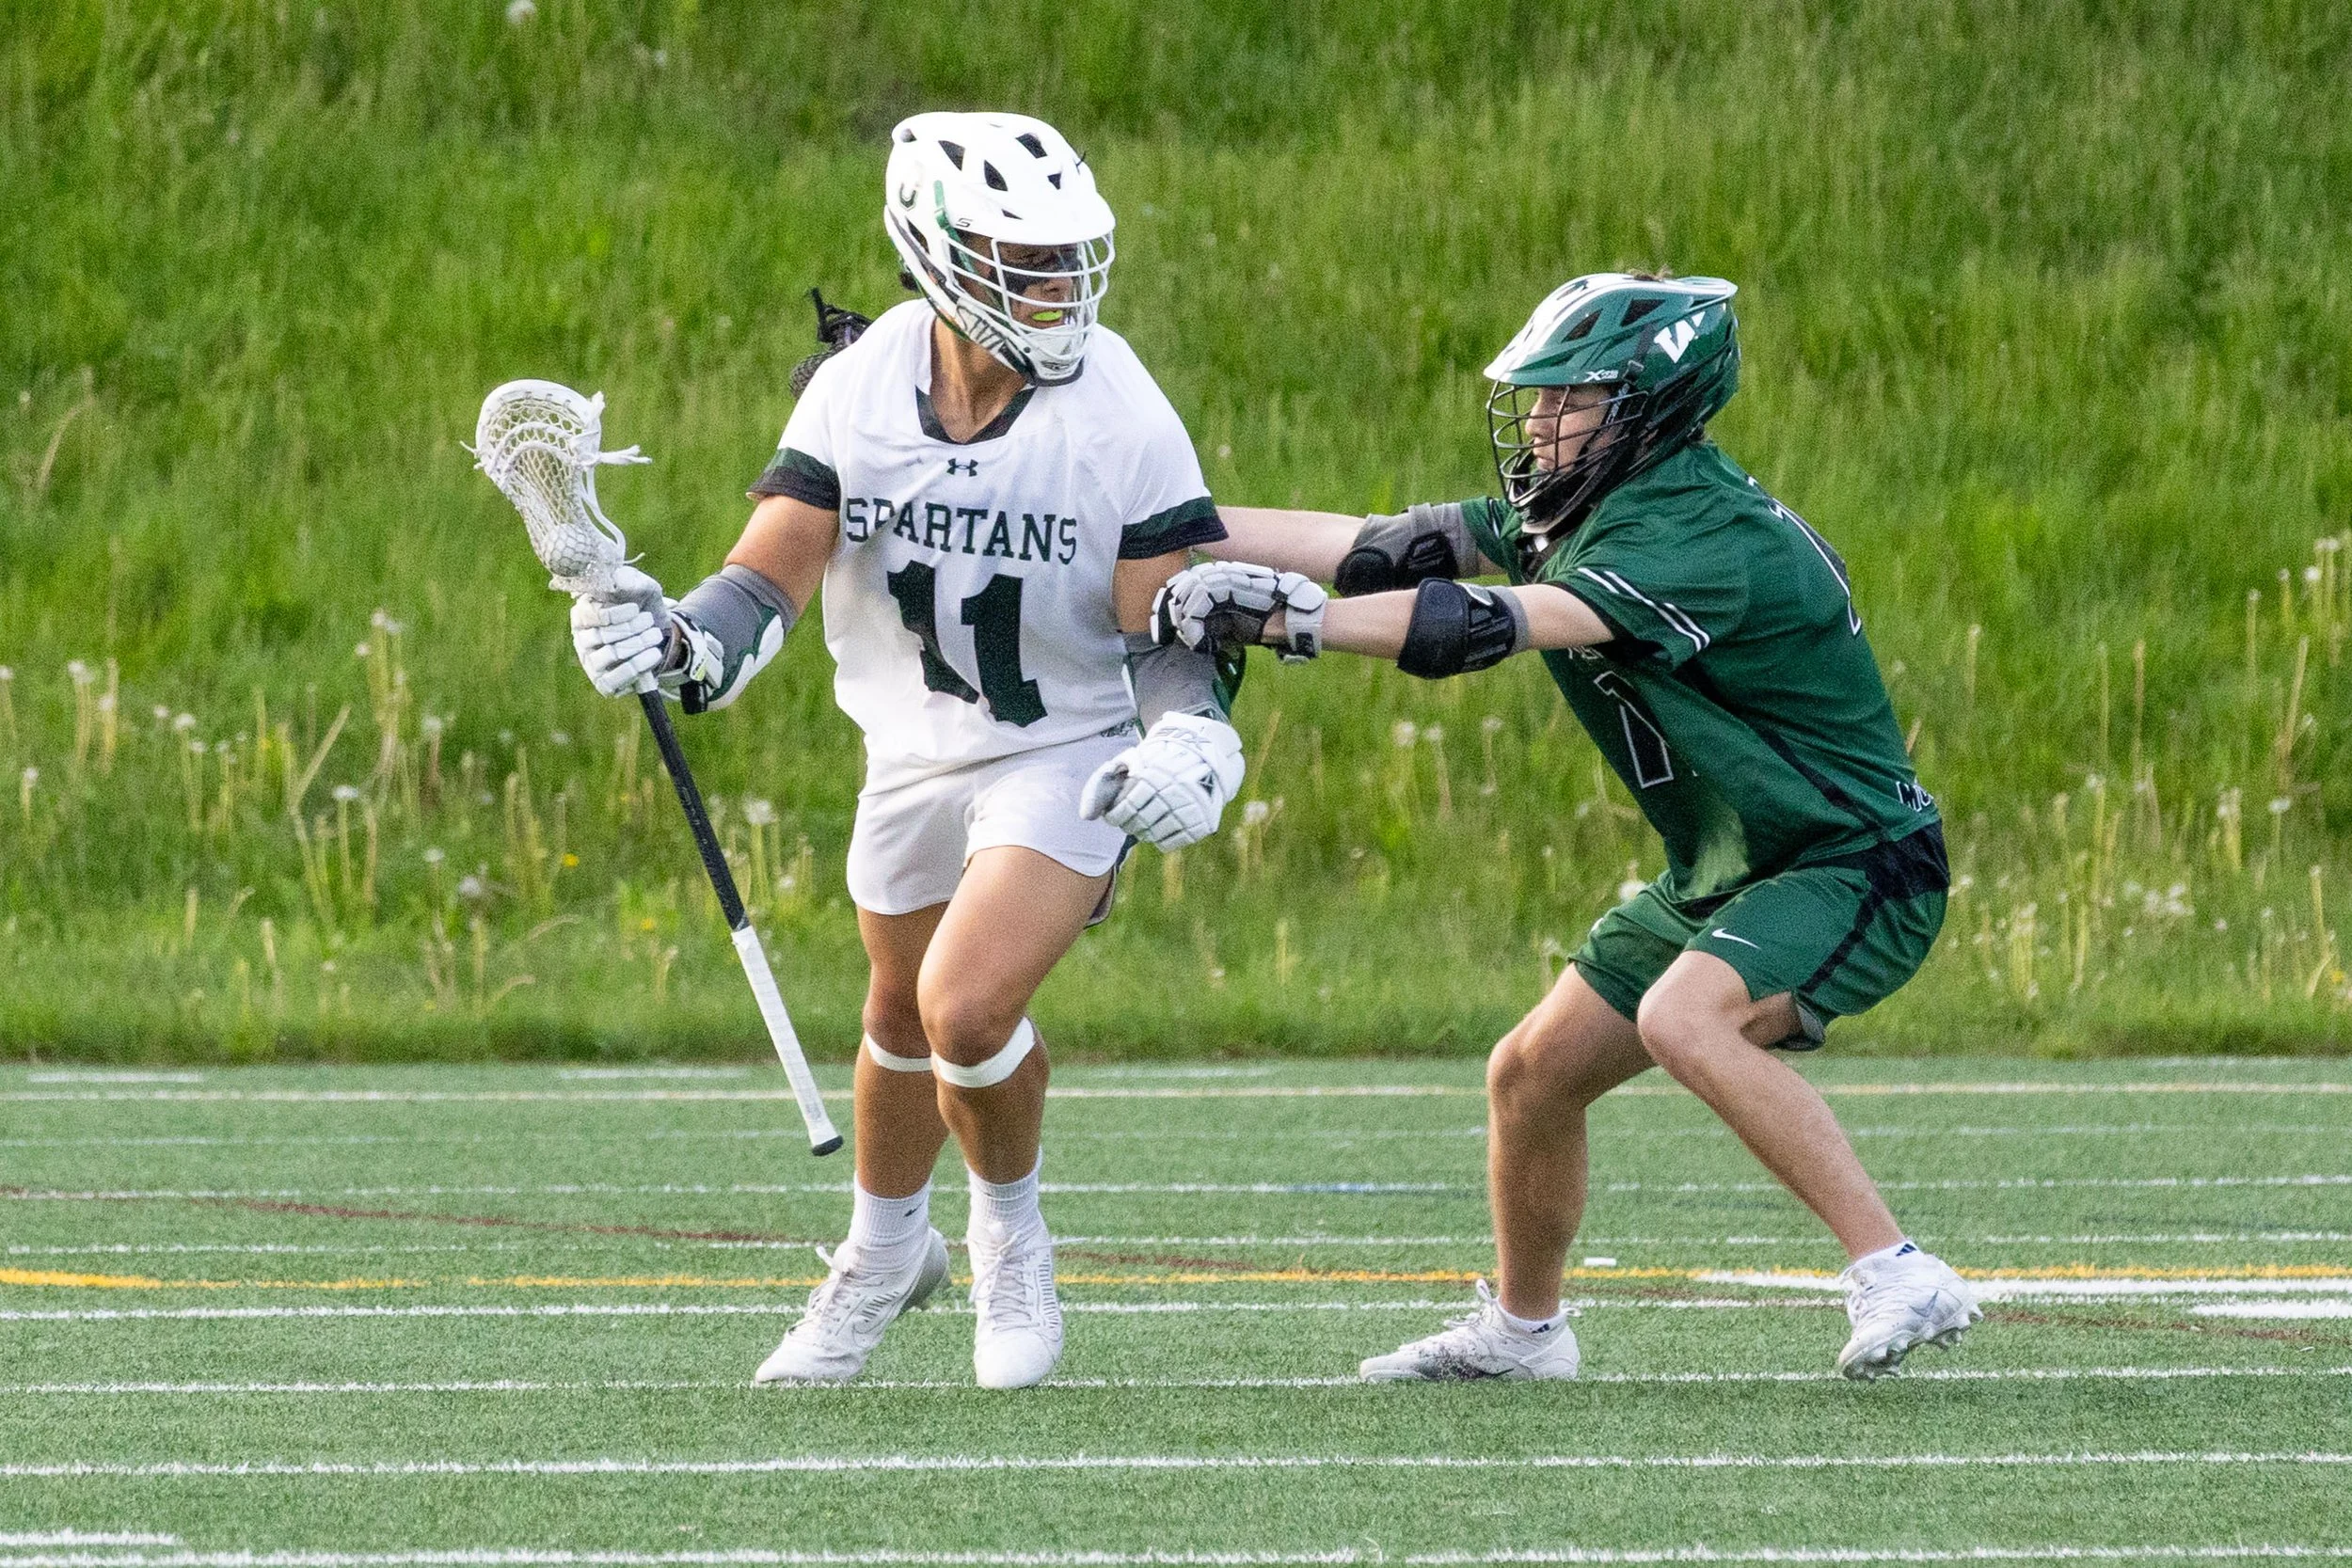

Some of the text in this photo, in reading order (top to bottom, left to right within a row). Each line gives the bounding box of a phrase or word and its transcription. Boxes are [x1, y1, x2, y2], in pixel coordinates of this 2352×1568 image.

[1654, 311, 1705, 364] W
[847, 498, 1077, 564] SPARTANS
[887, 561, 1048, 728] 11
